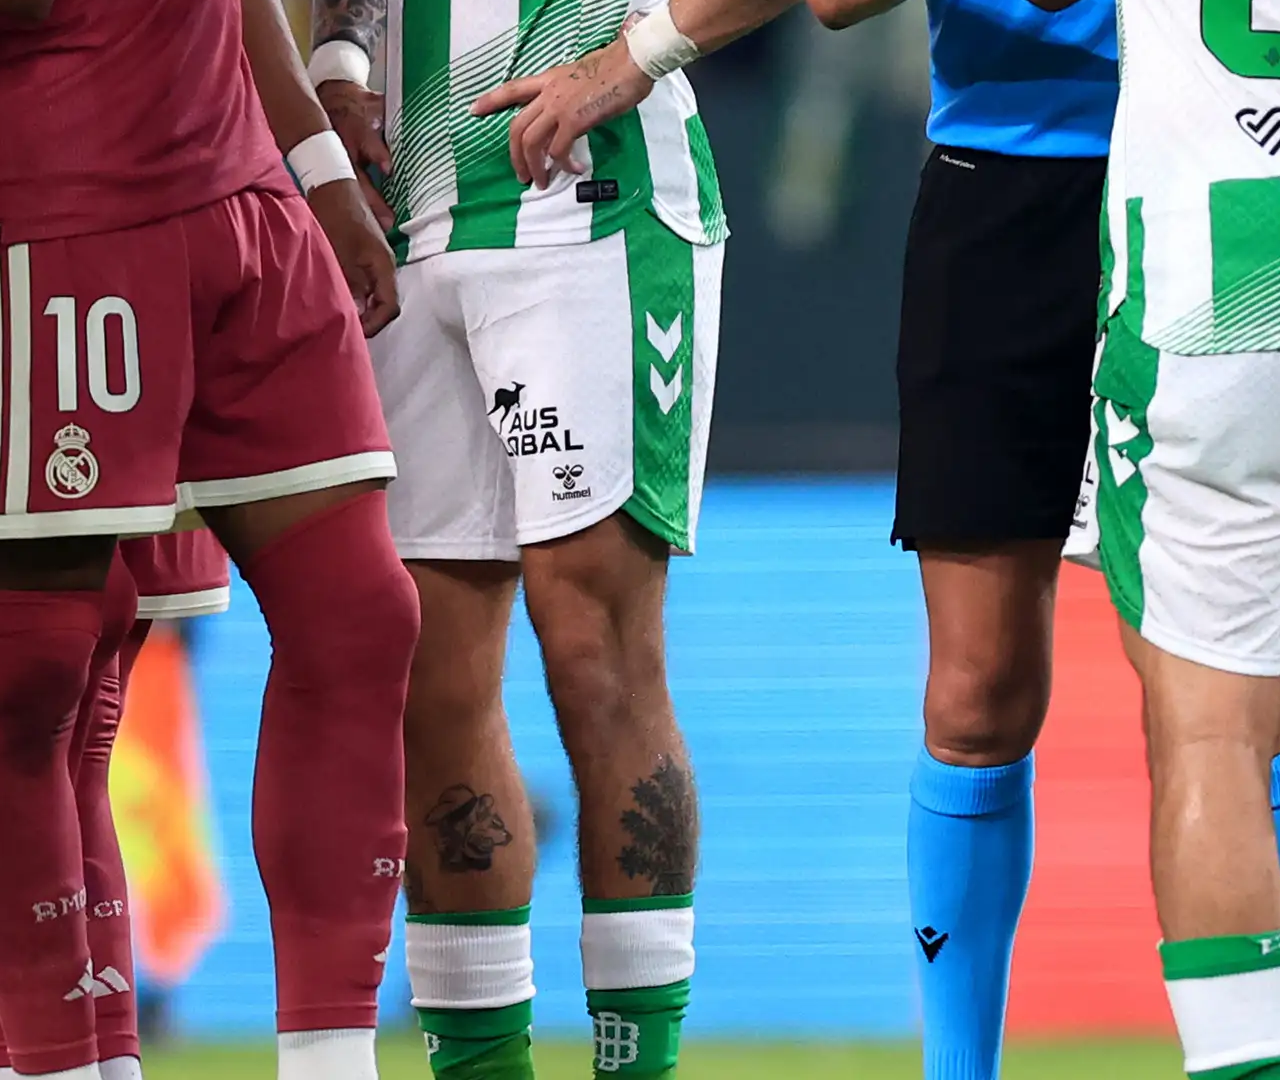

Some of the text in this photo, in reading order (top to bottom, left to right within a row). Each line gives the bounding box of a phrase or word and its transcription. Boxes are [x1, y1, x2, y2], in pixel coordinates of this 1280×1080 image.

[43, 295, 142, 413] 10
[508, 406, 559, 434] AUS
[552, 486, 591, 502] hummel
